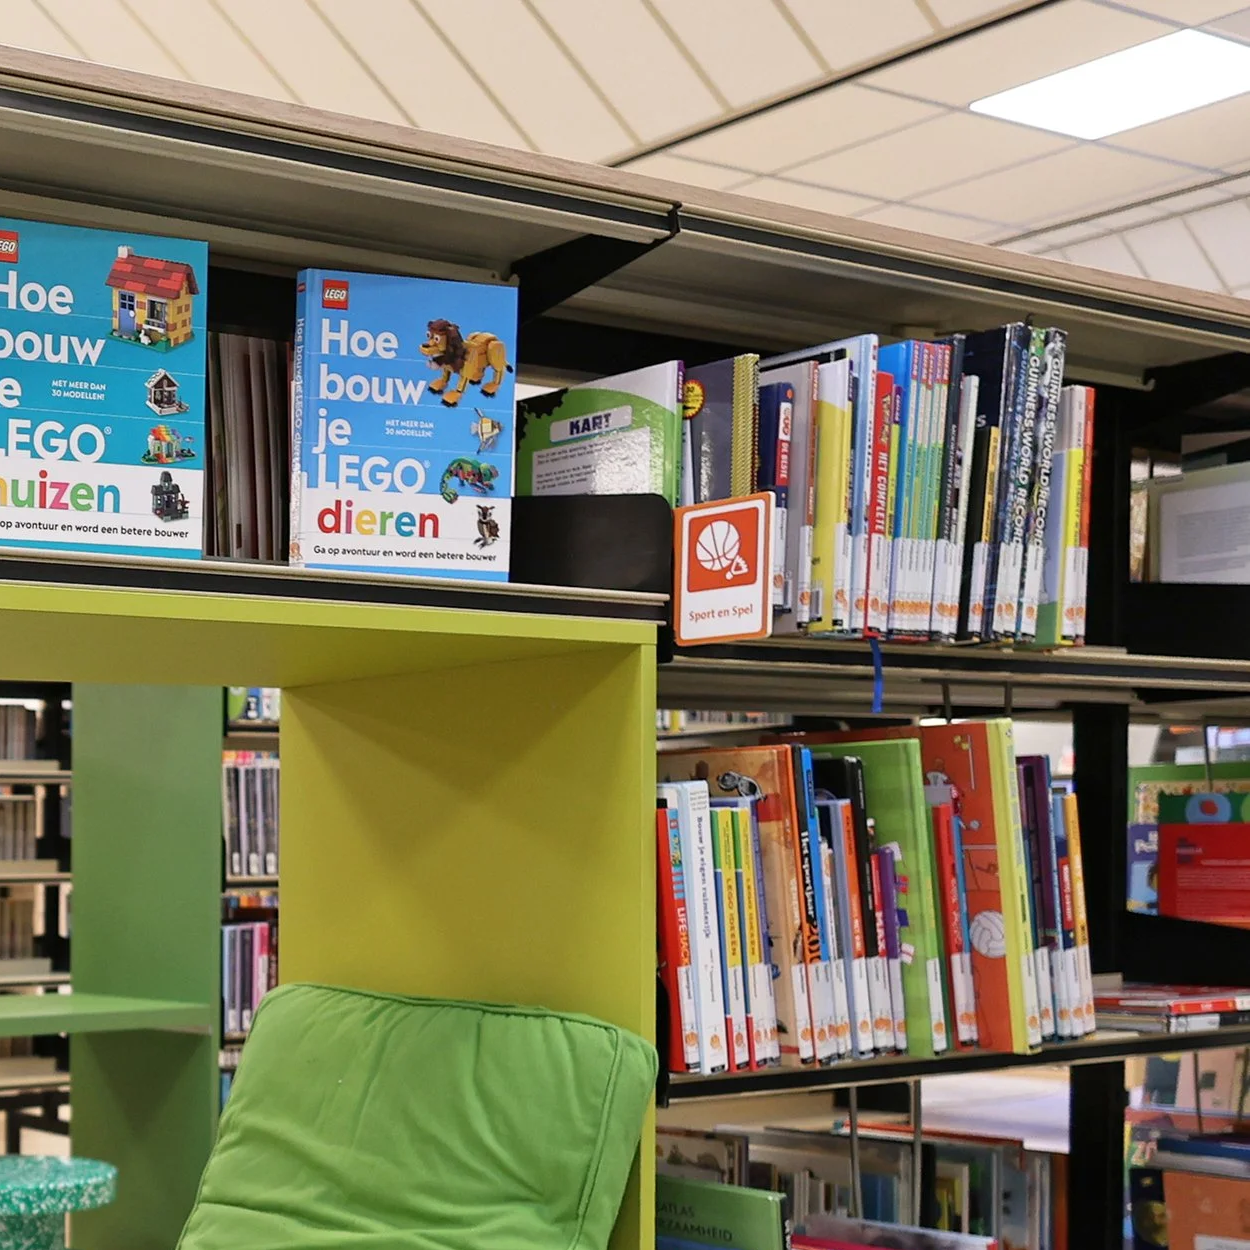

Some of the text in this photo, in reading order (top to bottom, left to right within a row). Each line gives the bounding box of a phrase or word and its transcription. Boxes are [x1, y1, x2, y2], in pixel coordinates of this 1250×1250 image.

[324, 287, 347, 301] LEGO
[321, 318, 399, 359] Hoe
[52, 389, 61, 397] 30
[69, 381, 89, 389] MEER
[90, 383, 106, 391] DAN
[319, 363, 427, 405] bouw
[1024, 356, 1040, 431] GUINNESS
[1046, 357, 1063, 430] GUINNESS
[312, 408, 352, 454] je
[878, 451, 888, 472] HET
[1019, 431, 1034, 485] WORLD
[1040, 431, 1054, 485] WORLD
[318, 499, 439, 539] dieren
[876, 475, 887, 532] COMPLETE
[0, 520, 12, 529] op
[15, 521, 58, 531] avontuur
[61, 523, 73, 532] en
[75, 524, 99, 533] word
[121, 527, 152, 536] betere
[154, 528, 189, 538] bouwer
[313, 545, 326, 554] Ga
[328, 546, 340, 555] op
[341, 547, 380, 556] avontuur
[395, 550, 416, 558] word
[436, 552, 464, 561] betere
[466, 553, 497, 562] bouwer
[689, 603, 753, 623] Sport en Spel
[696, 816, 705, 844] Bouw
[801, 831, 810, 854] Het
[698, 846, 706, 856] je
[698, 857, 708, 885] eigen
[726, 878, 734, 909] LEGO
[802, 856, 816, 919] sportjaar
[876, 911, 887, 952] MAX
